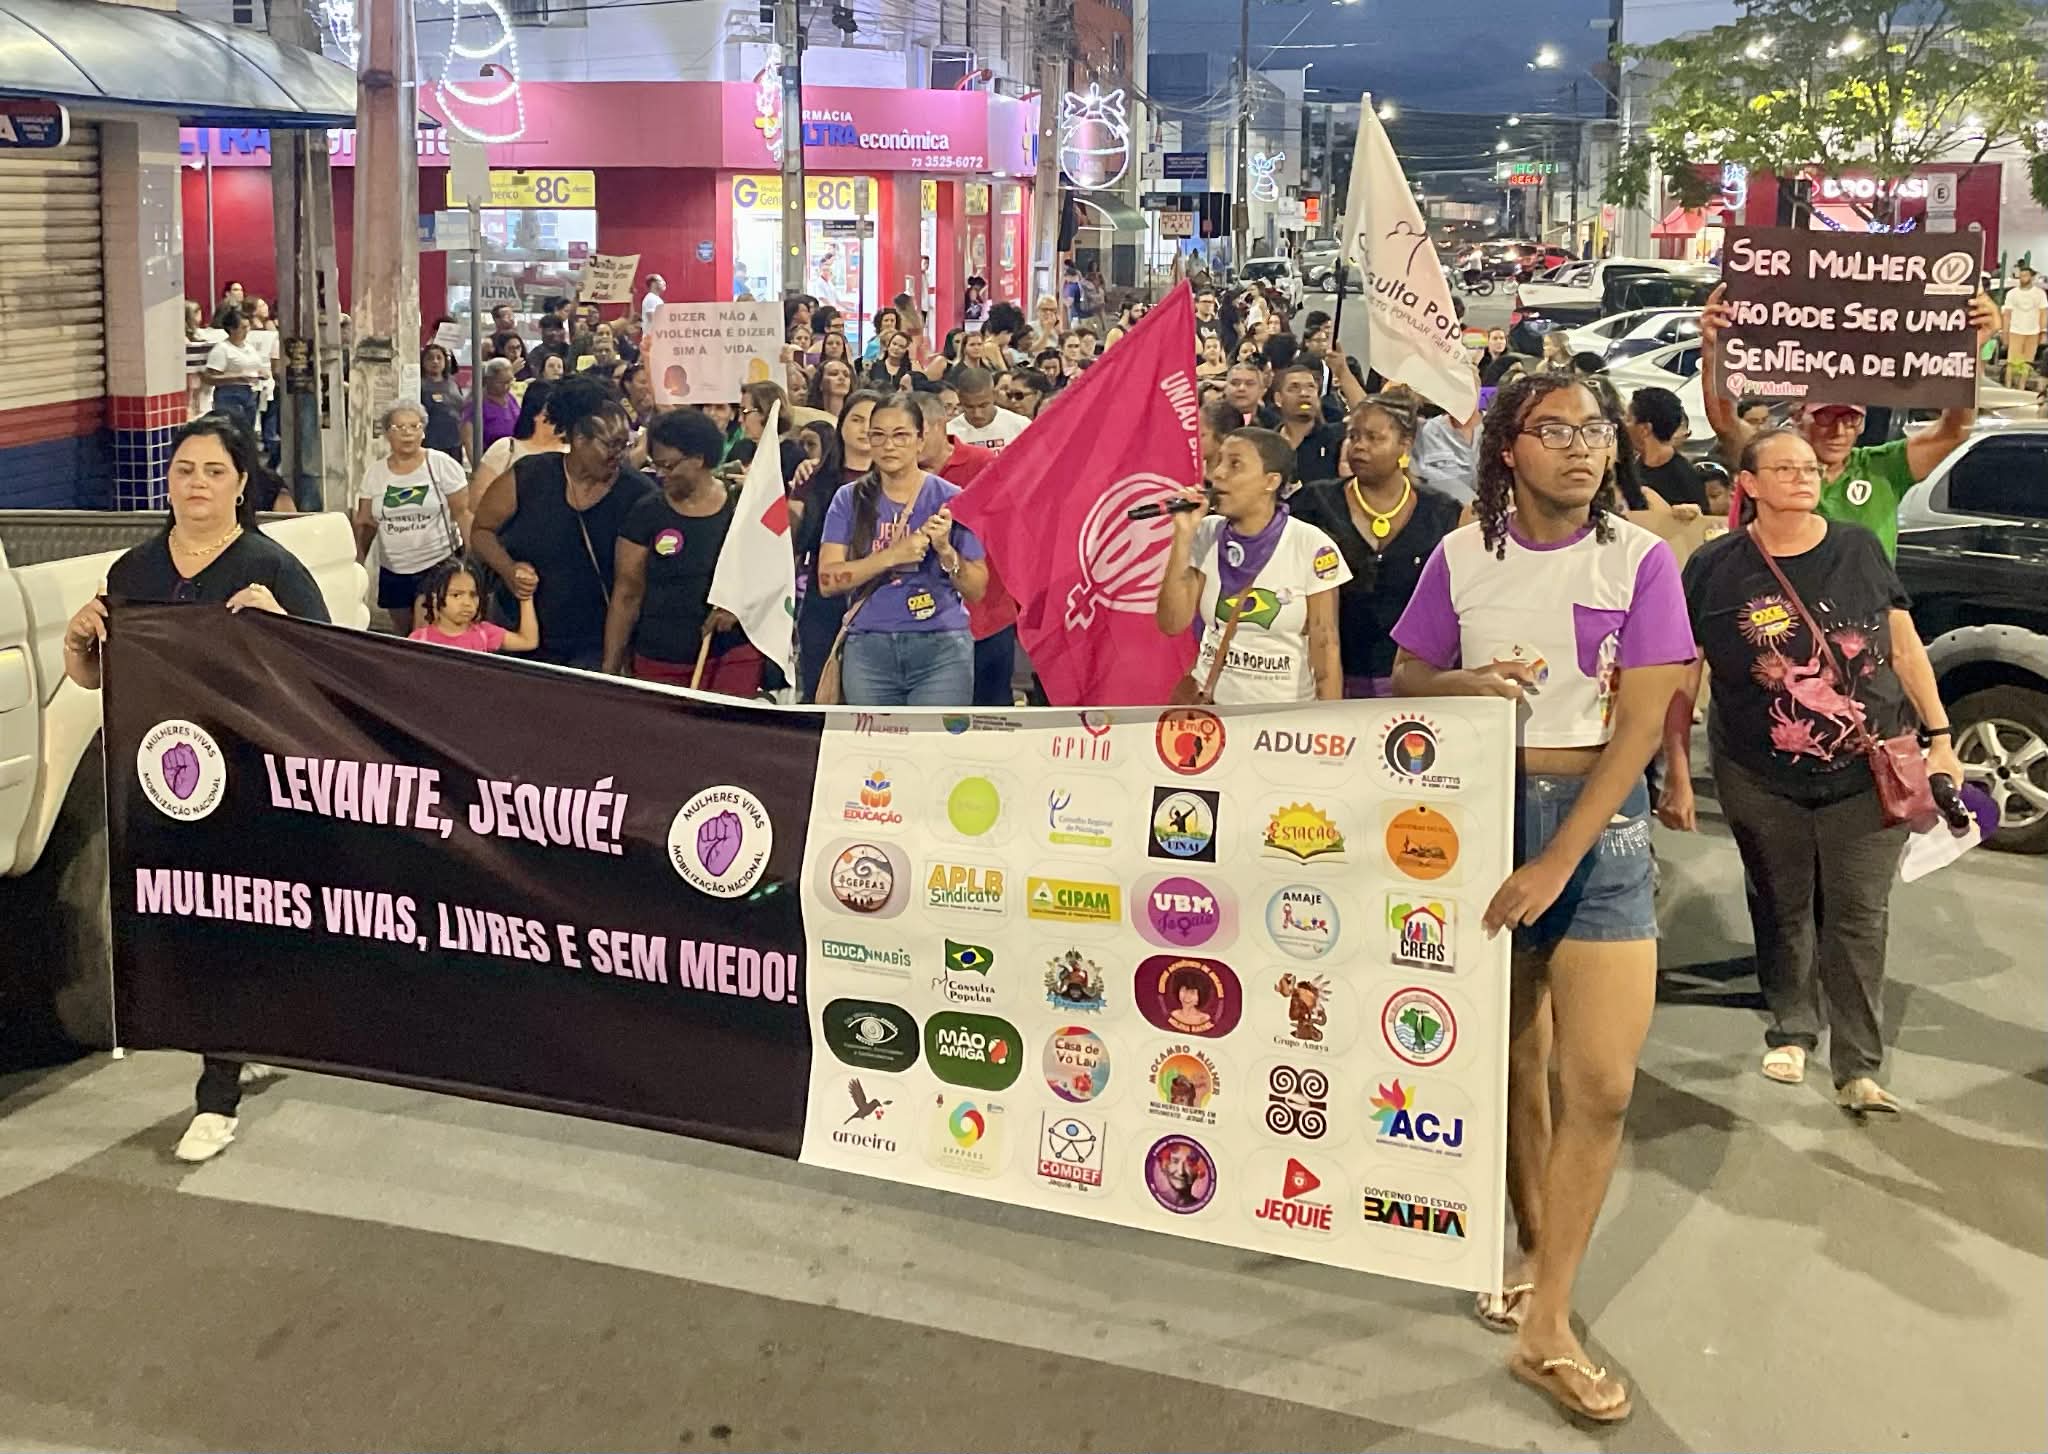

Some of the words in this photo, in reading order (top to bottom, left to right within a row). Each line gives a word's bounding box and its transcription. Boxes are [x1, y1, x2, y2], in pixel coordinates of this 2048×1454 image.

[859, 129, 949, 150] econômica
[911, 158, 922, 168] 73
[925, 155, 983, 168] 3525-6072
[734, 178, 759, 208] G
[1937, 187, 1945, 200] E
[1729, 238, 1791, 276] SER
[1809, 249, 1927, 281] MULHER
[669, 312, 706, 322] DIZER
[719, 311, 746, 321] NÃO
[1771, 301, 1836, 330] PODE
[1842, 302, 1899, 332] SER
[1905, 309, 1967, 332] UMA
[655, 328, 721, 339] VIOLÊNCIA
[738, 327, 775, 337] DIZER
[673, 346, 695, 356] SIM
[1724, 338, 1855, 379] SENTENÇA
[1862, 354, 1896, 378] DE
[1902, 351, 1976, 378] MORTE
[1243, 652, 1291, 671] POPULAR
[145, 726, 190, 752] MULHERES
[193, 731, 217, 758] VIVAS
[143, 772, 191, 816] MOBILIZAÇÃO
[192, 777, 221, 814] NACIONAL
[264, 753, 454, 839] LEVANTE,
[469, 775, 629, 855] JEQUIÉ!
[683, 792, 740, 821] MULHERES
[742, 798, 765, 829] VIVAS
[843, 809, 903, 824] EDUCAÇÃO
[673, 844, 726, 893] MOBILIZAÇÃO
[727, 851, 765, 893] NACIONAL
[927, 864, 1004, 897] APLB
[930, 886, 1001, 904] Sindicato
[1057, 889, 1110, 913] CIPAM
[1153, 893, 1214, 914] UBM
[1282, 892, 1323, 906] AMAJE
[135, 867, 312, 930] MULHERES
[322, 886, 428, 952] VIVAS,
[438, 901, 552, 963] LIVRES
[560, 923, 582, 969] E
[591, 928, 667, 985] SEM
[680, 938, 799, 1004] MEDO!
[1400, 940, 1446, 962] CREAS
[938, 1026, 986, 1049] MÃO
[1055, 1038, 1082, 1052] Casa
[1085, 1043, 1100, 1056] de
[939, 1047, 986, 1063] AMIGA
[1076, 1056, 1097, 1069] Lau
[1149, 1044, 1190, 1083] MOCAMBO
[1197, 1050, 1220, 1096] MULHER
[1389, 1109, 1464, 1148] ACJ
[832, 1130, 896, 1153] aroeira
[1040, 1161, 1101, 1185] COMDEF
[1364, 1187, 1412, 1203] GOVERNO
[1414, 1195, 1429, 1205] DO
[1430, 1198, 1468, 1212] ESTADO
[1255, 1198, 1333, 1231] JEQUIÉ
[1364, 1196, 1466, 1238] BAHIA
